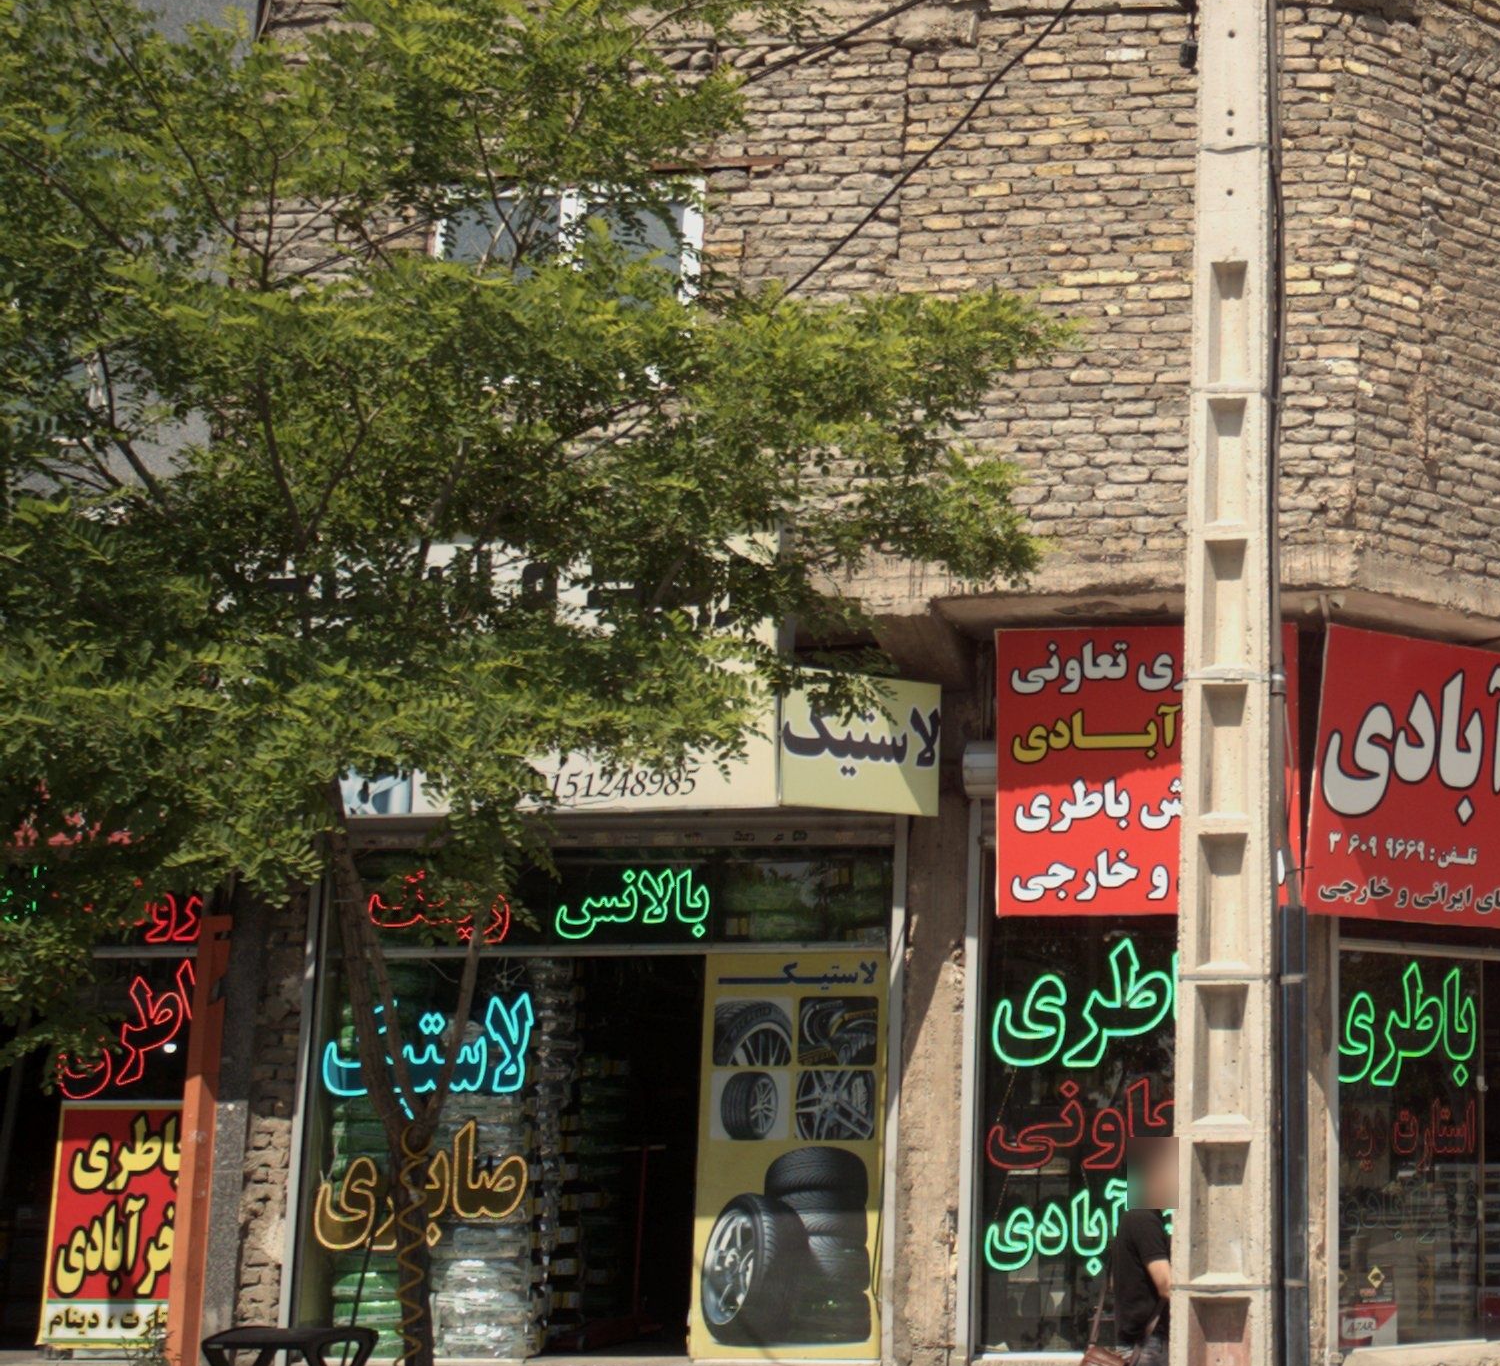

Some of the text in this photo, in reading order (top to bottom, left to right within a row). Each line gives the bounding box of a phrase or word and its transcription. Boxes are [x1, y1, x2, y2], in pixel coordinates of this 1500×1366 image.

[1010, 638, 1129, 695] تعاونی
[783, 703, 941, 776] لاستیک
[1011, 702, 1183, 764] آبادی
[1014, 777, 1131, 833] باطری
[555, 867, 710, 939] بالانس
[1011, 848, 1170, 902] و خارجی
[1319, 877, 1392, 905] خارجی
[1396, 887, 1408, 907] و
[1412, 883, 1472, 912] ایرانی
[718, 961, 878, 990] لاستیک
[992, 938, 1179, 1068] طری
[57, 958, 196, 1099] اطری
[1339, 962, 1476, 1087] باطری
[134, 1204, 176, 1297] خر
